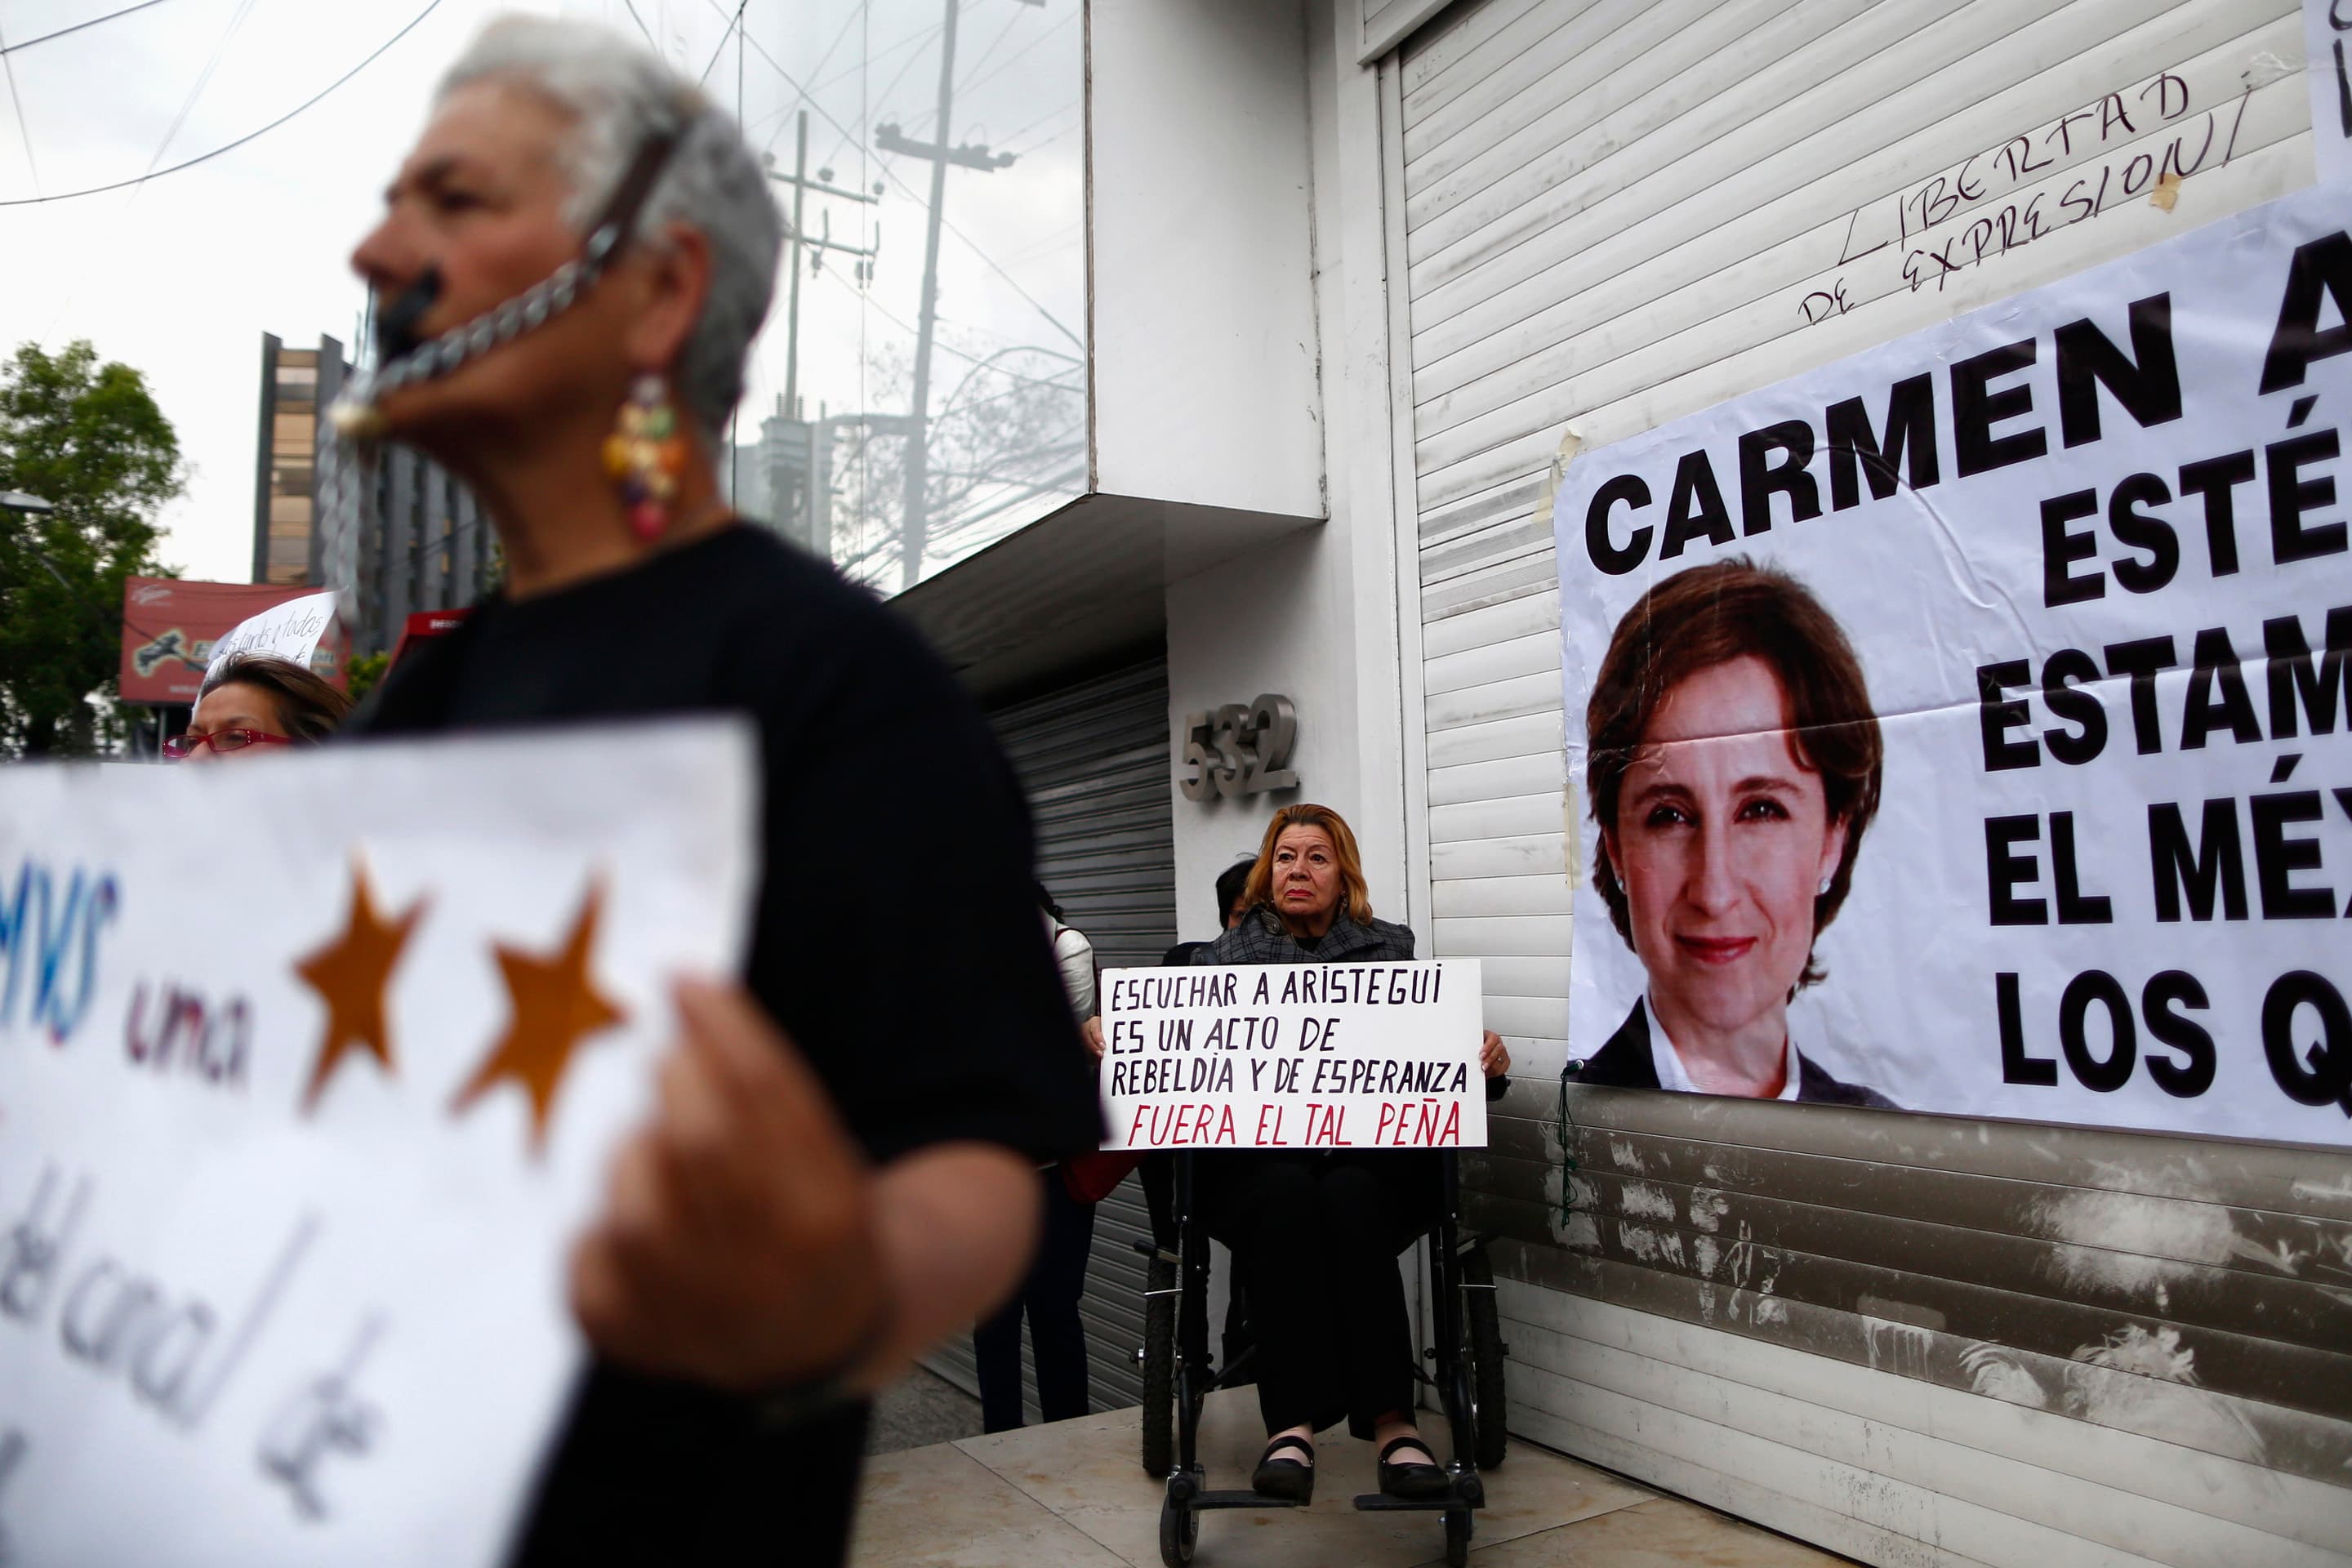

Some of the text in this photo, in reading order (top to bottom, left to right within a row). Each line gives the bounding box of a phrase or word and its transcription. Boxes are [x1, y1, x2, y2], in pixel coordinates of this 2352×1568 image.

[1838, 73, 2189, 266] LIBERTAD
[1797, 278, 1855, 326] DE
[1585, 292, 2183, 577] CARMEN
[2040, 394, 2350, 608] ESTÉ
[1179, 693, 1297, 803] 532
[1984, 753, 2352, 926] EL MÉ
[1111, 964, 1443, 1012] ESCUCHAR A ARISTEGUI
[1112, 1016, 1340, 1054] ES UN ACTO DE
[1995, 969, 2216, 1098] LOS
[1128, 1098, 1460, 1147] FUERA EL TAL PEÑA
[1251, 1060, 1268, 1093] Y
[1274, 1058, 1304, 1094] DE
[1312, 1059, 1468, 1094] ESPERANZA
